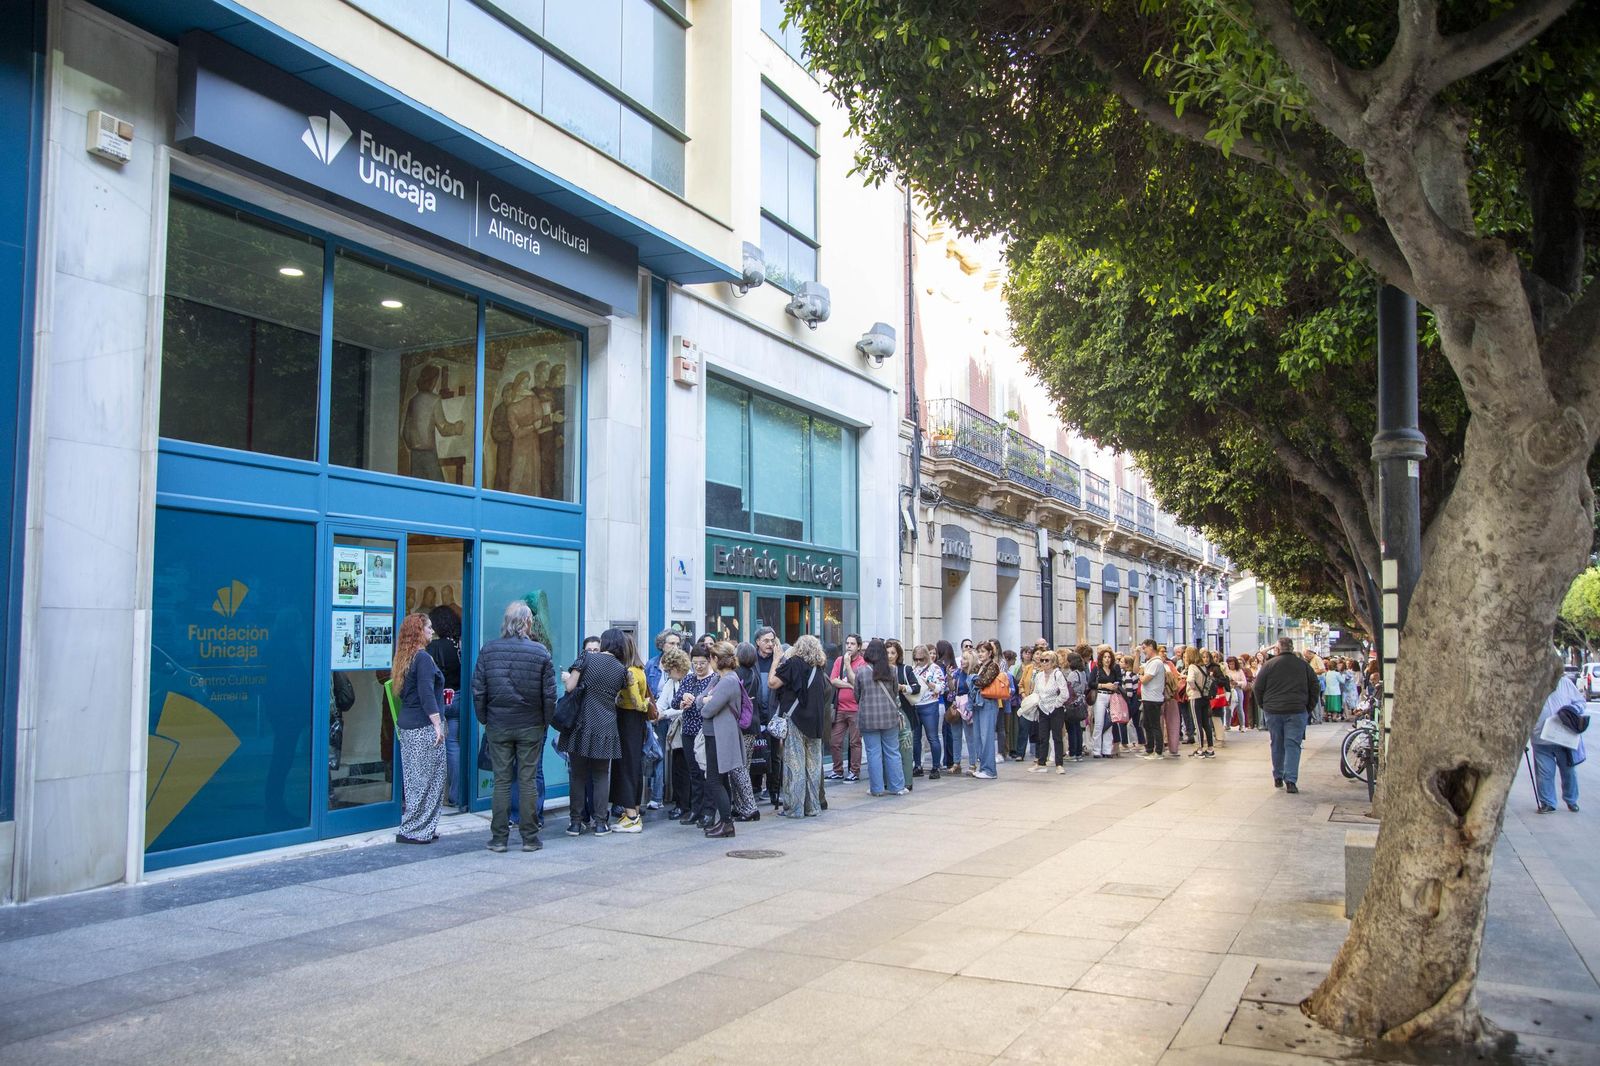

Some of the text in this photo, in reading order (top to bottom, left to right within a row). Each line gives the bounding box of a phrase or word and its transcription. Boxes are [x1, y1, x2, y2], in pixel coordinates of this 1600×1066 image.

[358, 157, 436, 213] Unicaja
[360, 130, 464, 199] Fundación
[488, 193, 590, 255] Centro Cultural
[488, 217, 541, 256] Almería
[713, 544, 842, 590] Edificio Unicaja
[188, 624, 268, 640] Fundación
[200, 642, 258, 661] Unicaja
[190, 674, 266, 687] Centro Cultural
